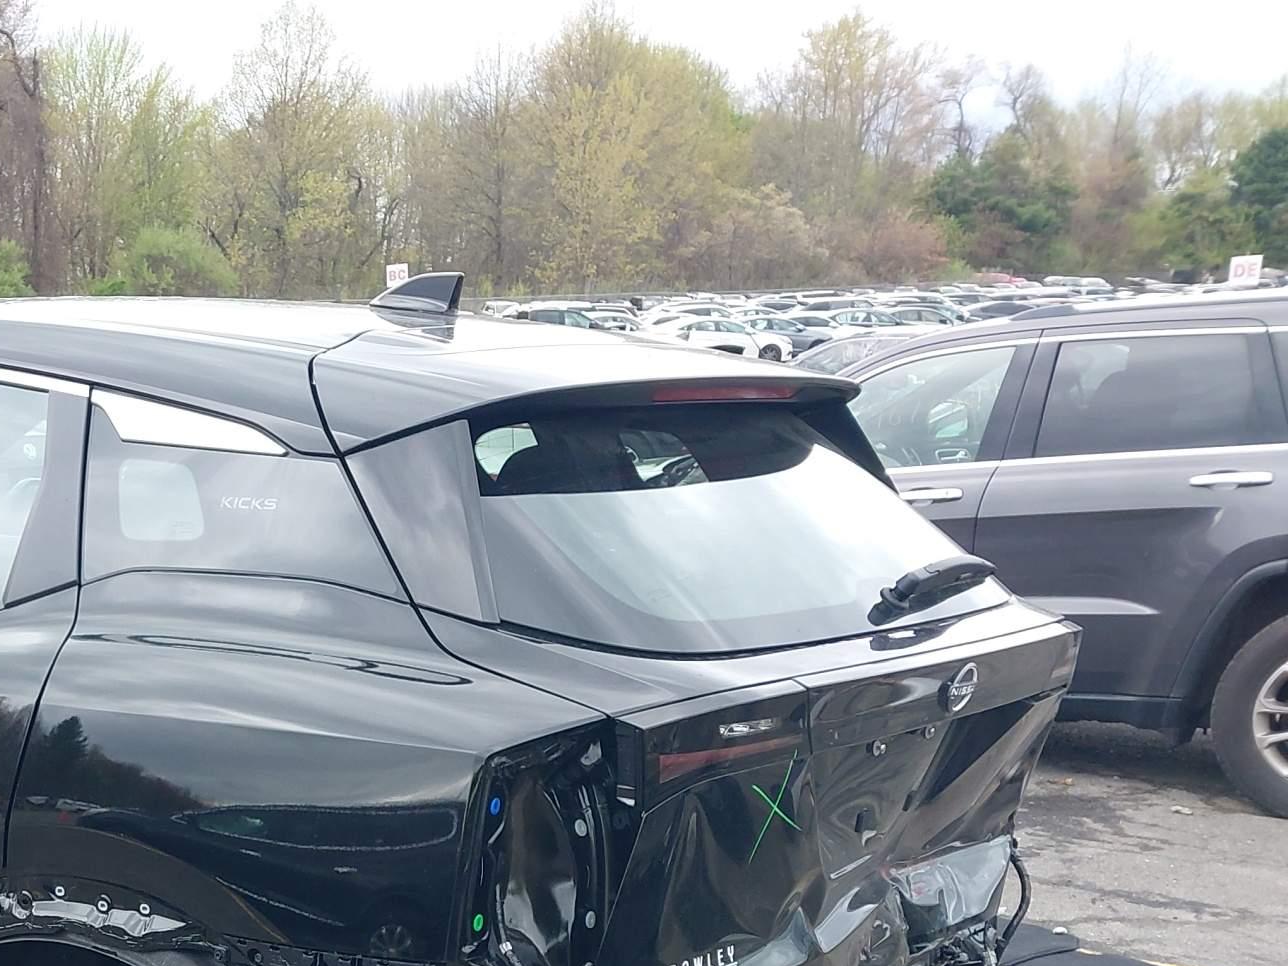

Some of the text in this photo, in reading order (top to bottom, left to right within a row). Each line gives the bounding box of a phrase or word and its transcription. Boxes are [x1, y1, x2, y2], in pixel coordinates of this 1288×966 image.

[388, 269, 406, 281] BC
[1234, 262, 1258, 277] DE
[219, 496, 278, 510] KICKS
